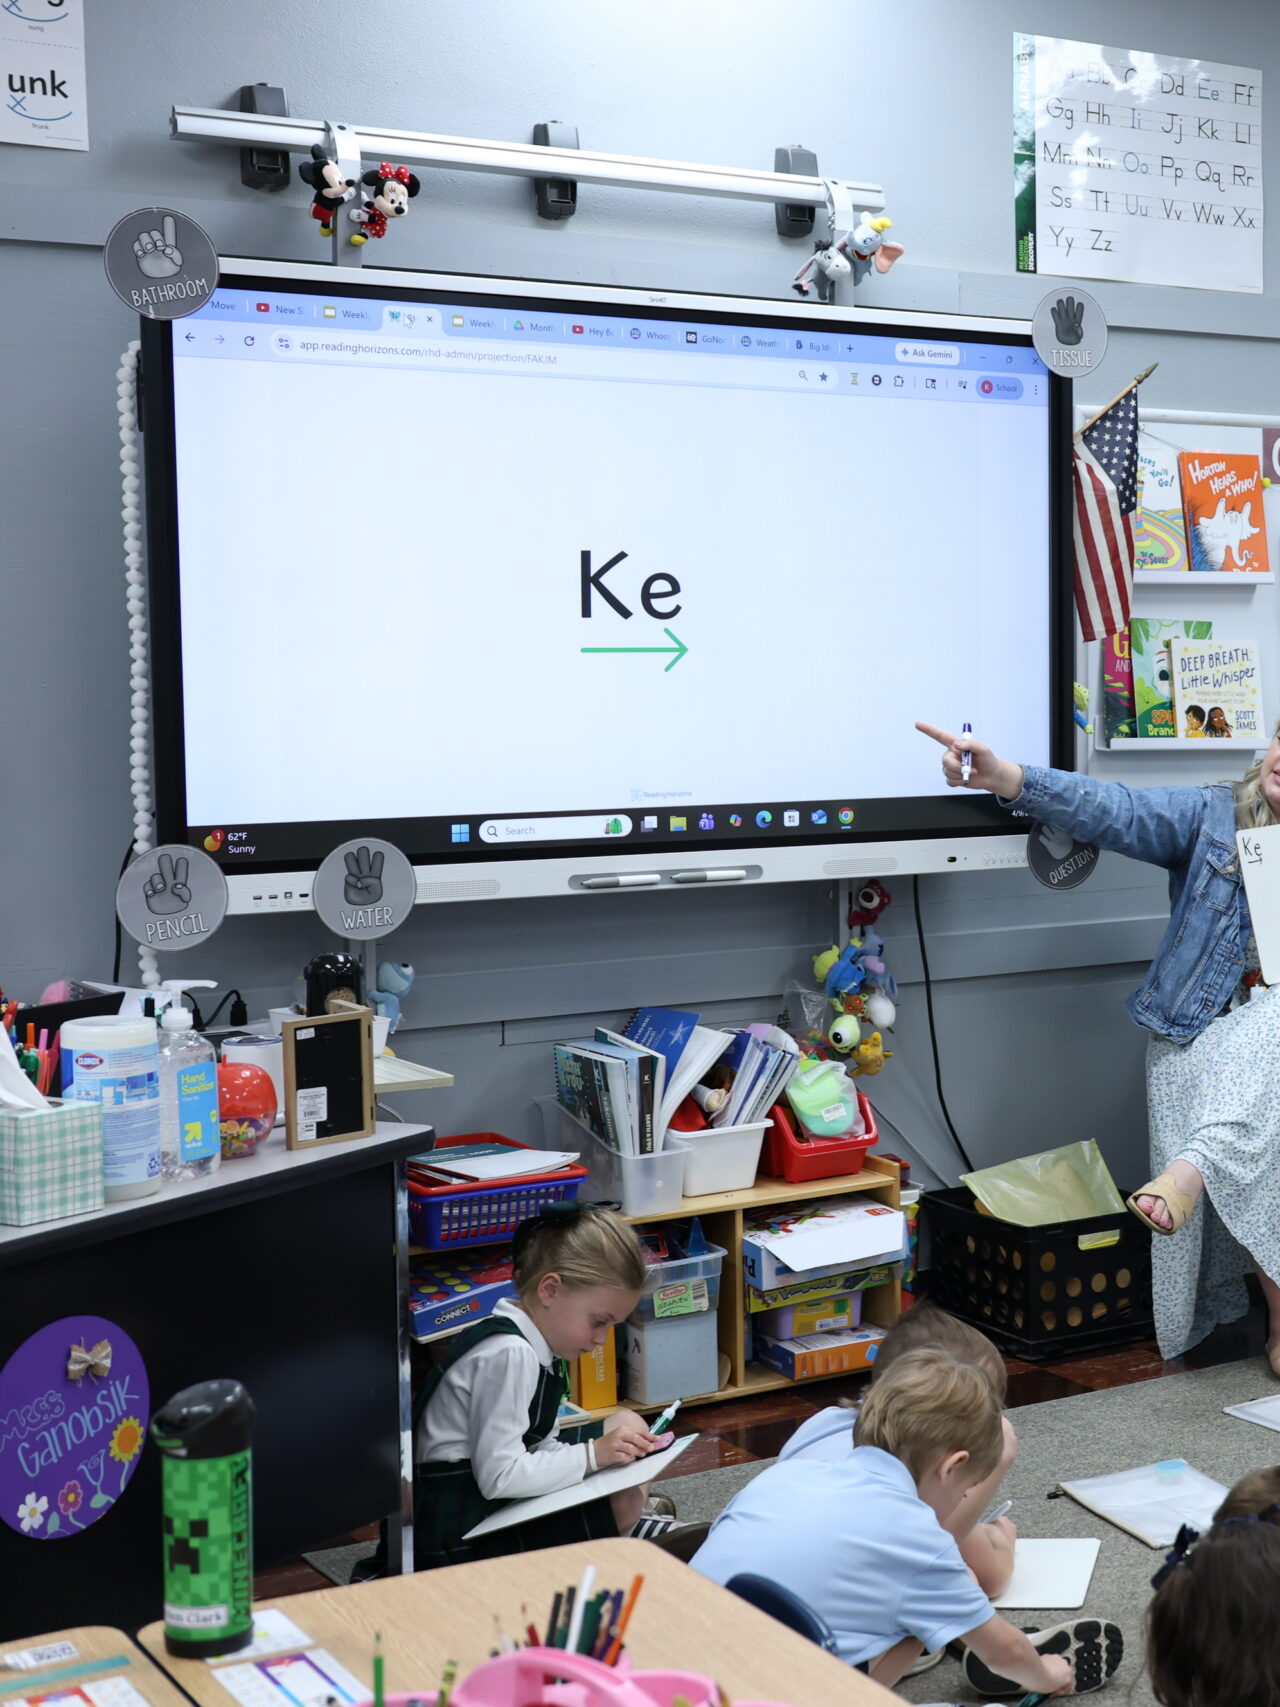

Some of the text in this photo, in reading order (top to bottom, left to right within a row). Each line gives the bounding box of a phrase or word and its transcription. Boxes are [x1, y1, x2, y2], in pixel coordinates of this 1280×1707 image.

[8, 69, 69, 99] unk
[1161, 72, 1255, 105] Dd Ee Ff
[1046, 97, 1251, 144] Gg Hh Ii Jj Kk Ll
[1043, 140, 1078, 167] Mm
[1123, 151, 1149, 174] Oo
[1161, 156, 1184, 186] Pp
[1195, 160, 1226, 192] Qq
[1233, 165, 1254, 187] Rr
[1050, 186, 1255, 229] Ss Tt Uu Vv Ww Xx
[1049, 225, 1113, 258] Yy Zz
[131, 277, 210, 308] BATHROOM
[912, 348, 953, 360] Ask Gemini
[1050, 348, 1093, 368] TISSUE
[995, 382, 1017, 393] School
[1158, 475, 1175, 488] Go!
[1209, 470, 1237, 495] HEARS
[1225, 470, 1258, 497] A WHO!
[580, 549, 683, 620] Ke
[1180, 656, 1205, 672] DEEP
[1181, 667, 1256, 690] Little Whisper
[1235, 710, 1255, 721] SCOTT
[1235, 720, 1257, 731] JAMES
[227, 831, 248, 842] 62°F
[505, 824, 535, 836] Search
[228, 844, 256, 855] Sunny
[1242, 836, 1263, 857] Ke
[1049, 847, 1095, 885] QUESTION
[145, 912, 210, 943] PENCIL
[340, 906, 394, 930] WATER
[181, 1072, 205, 1084] Hand
[181, 1081, 214, 1095] Sanitizer
[435, 1305, 471, 1325] CONNECT
